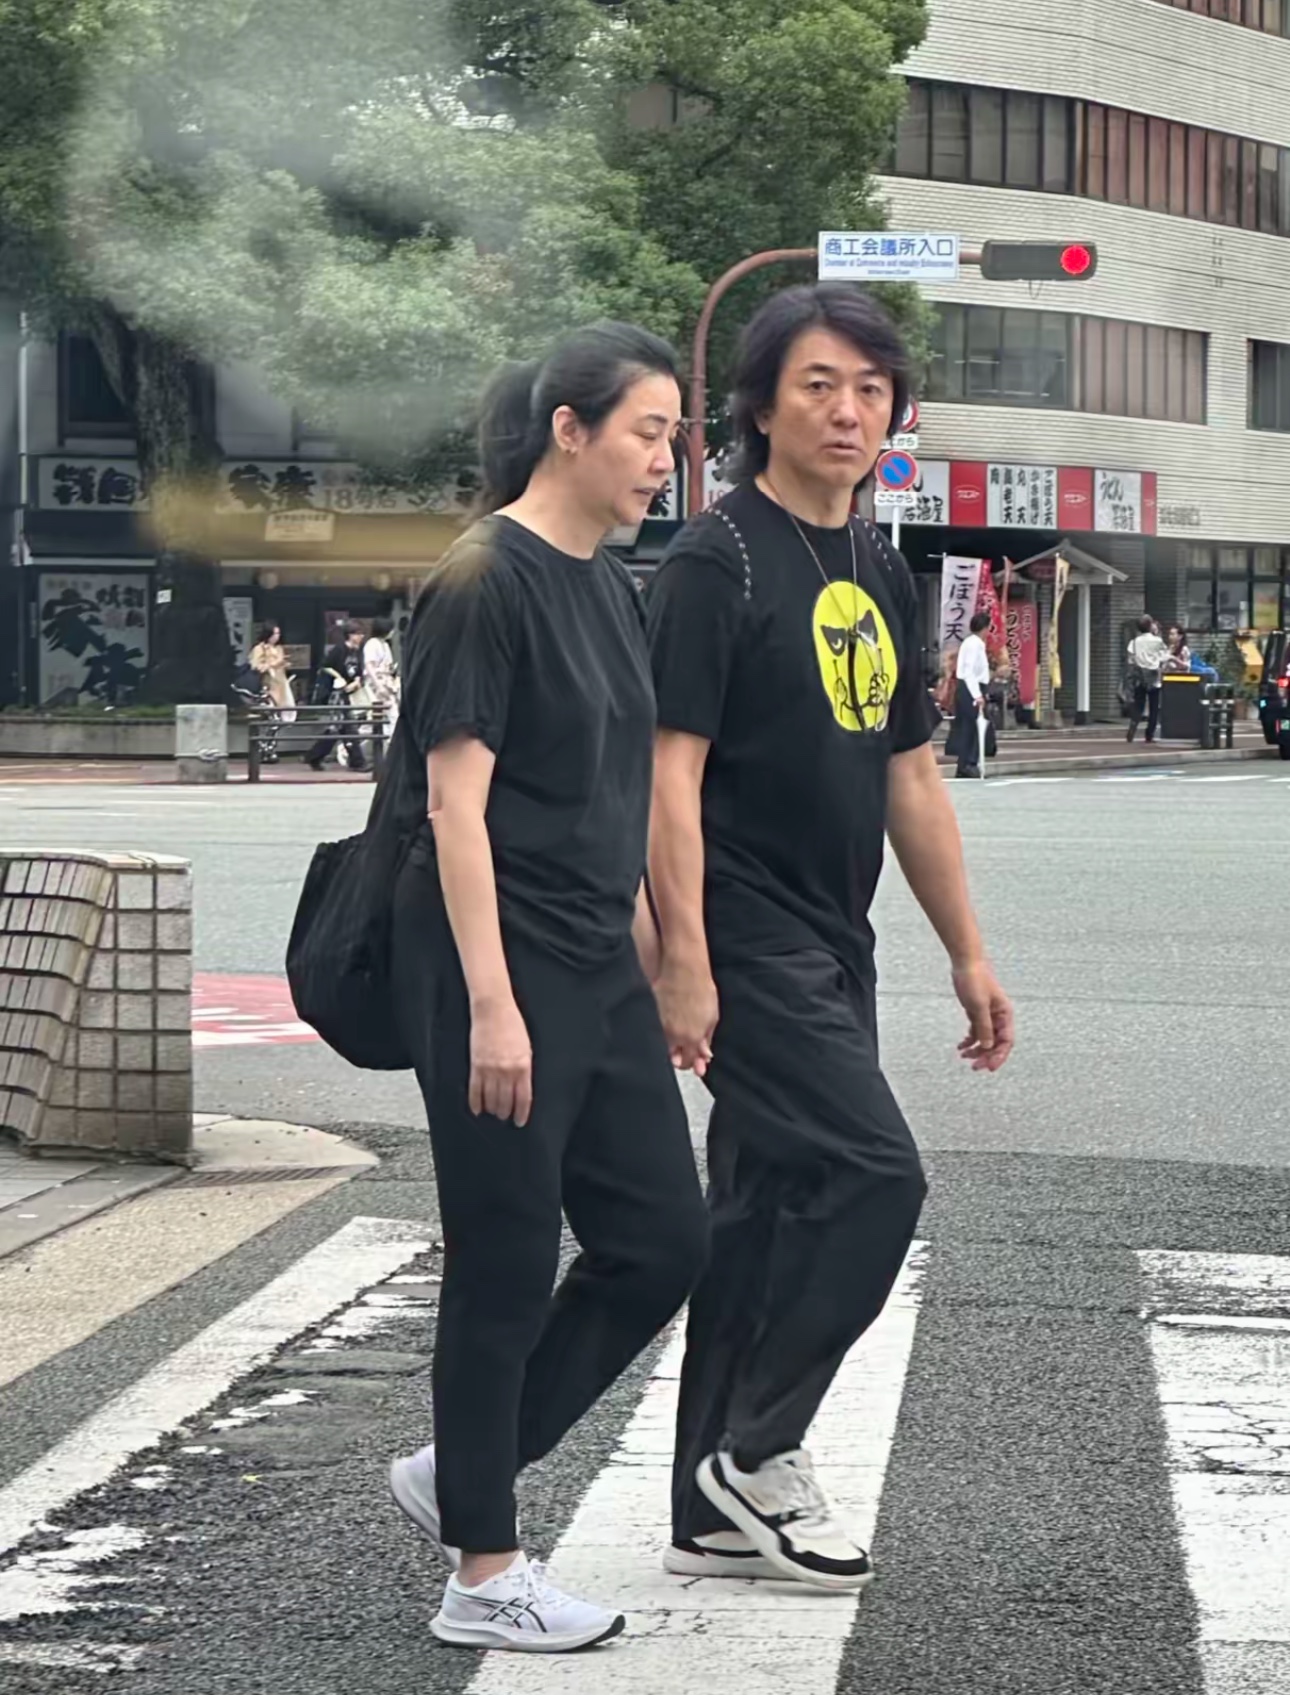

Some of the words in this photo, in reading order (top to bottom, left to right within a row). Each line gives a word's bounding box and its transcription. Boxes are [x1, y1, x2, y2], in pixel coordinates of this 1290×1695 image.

[825, 237, 954, 256] 商工会議所入口
[877, 493, 914, 504] ここから
[1043, 469, 1054, 527] ごぼう天
[943, 563, 976, 642] ごぼう天
